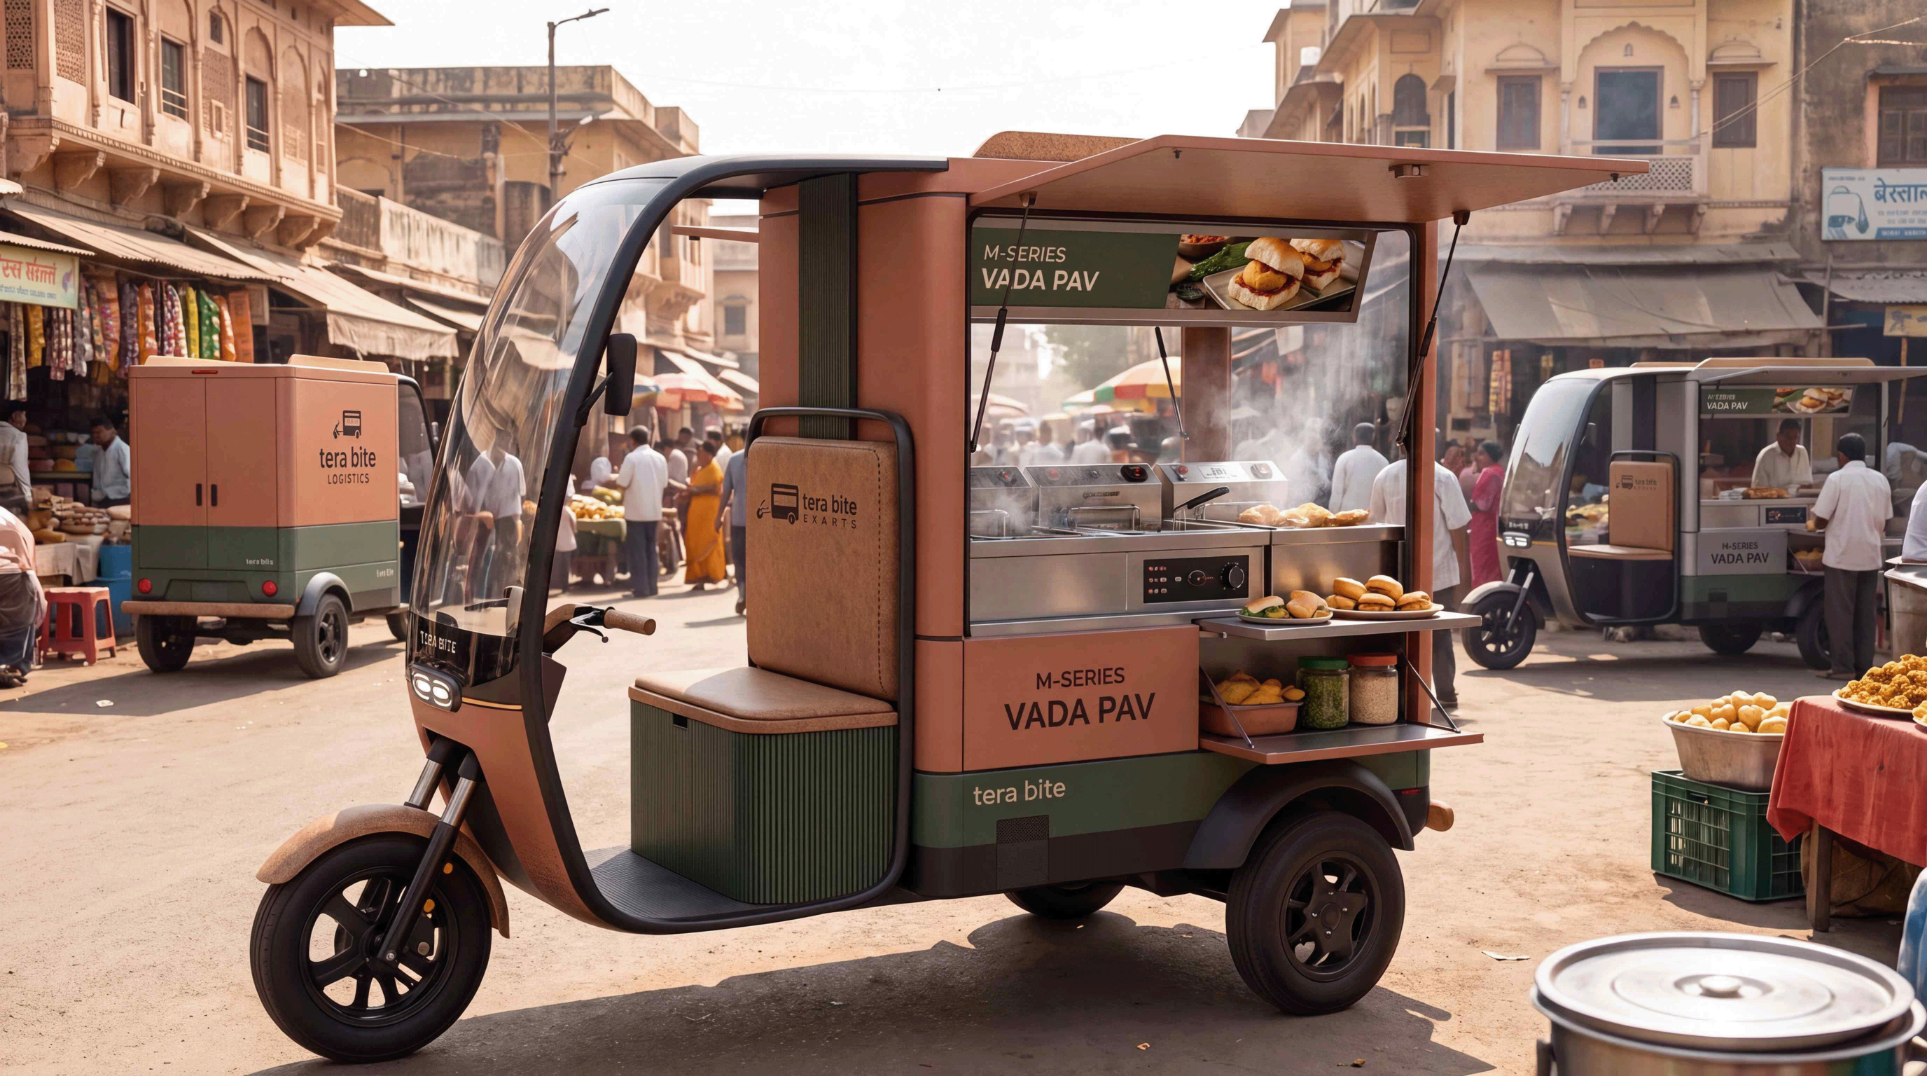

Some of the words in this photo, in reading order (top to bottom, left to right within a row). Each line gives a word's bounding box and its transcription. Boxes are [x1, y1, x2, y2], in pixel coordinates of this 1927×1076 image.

[984, 244, 1066, 263] M-SERIES
[981, 267, 1046, 290] VADA
[1052, 270, 1100, 292] PAV
[1706, 401, 1729, 410] VADA
[1731, 401, 1748, 410] PAV
[319, 448, 347, 468] tera
[351, 446, 376, 467] bite
[327, 472, 370, 485] LOGISTICS
[802, 493, 828, 512] tera
[831, 494, 857, 516] bite
[803, 514, 857, 530] EXARTS
[1711, 553, 1744, 564] VADA
[1746, 552, 1769, 564] PAV
[1036, 667, 1126, 690] M-SERIES
[1004, 698, 1090, 731] VADA
[1098, 692, 1156, 724] PAV
[973, 786, 1017, 806] tera
[1024, 778, 1066, 801] bite
